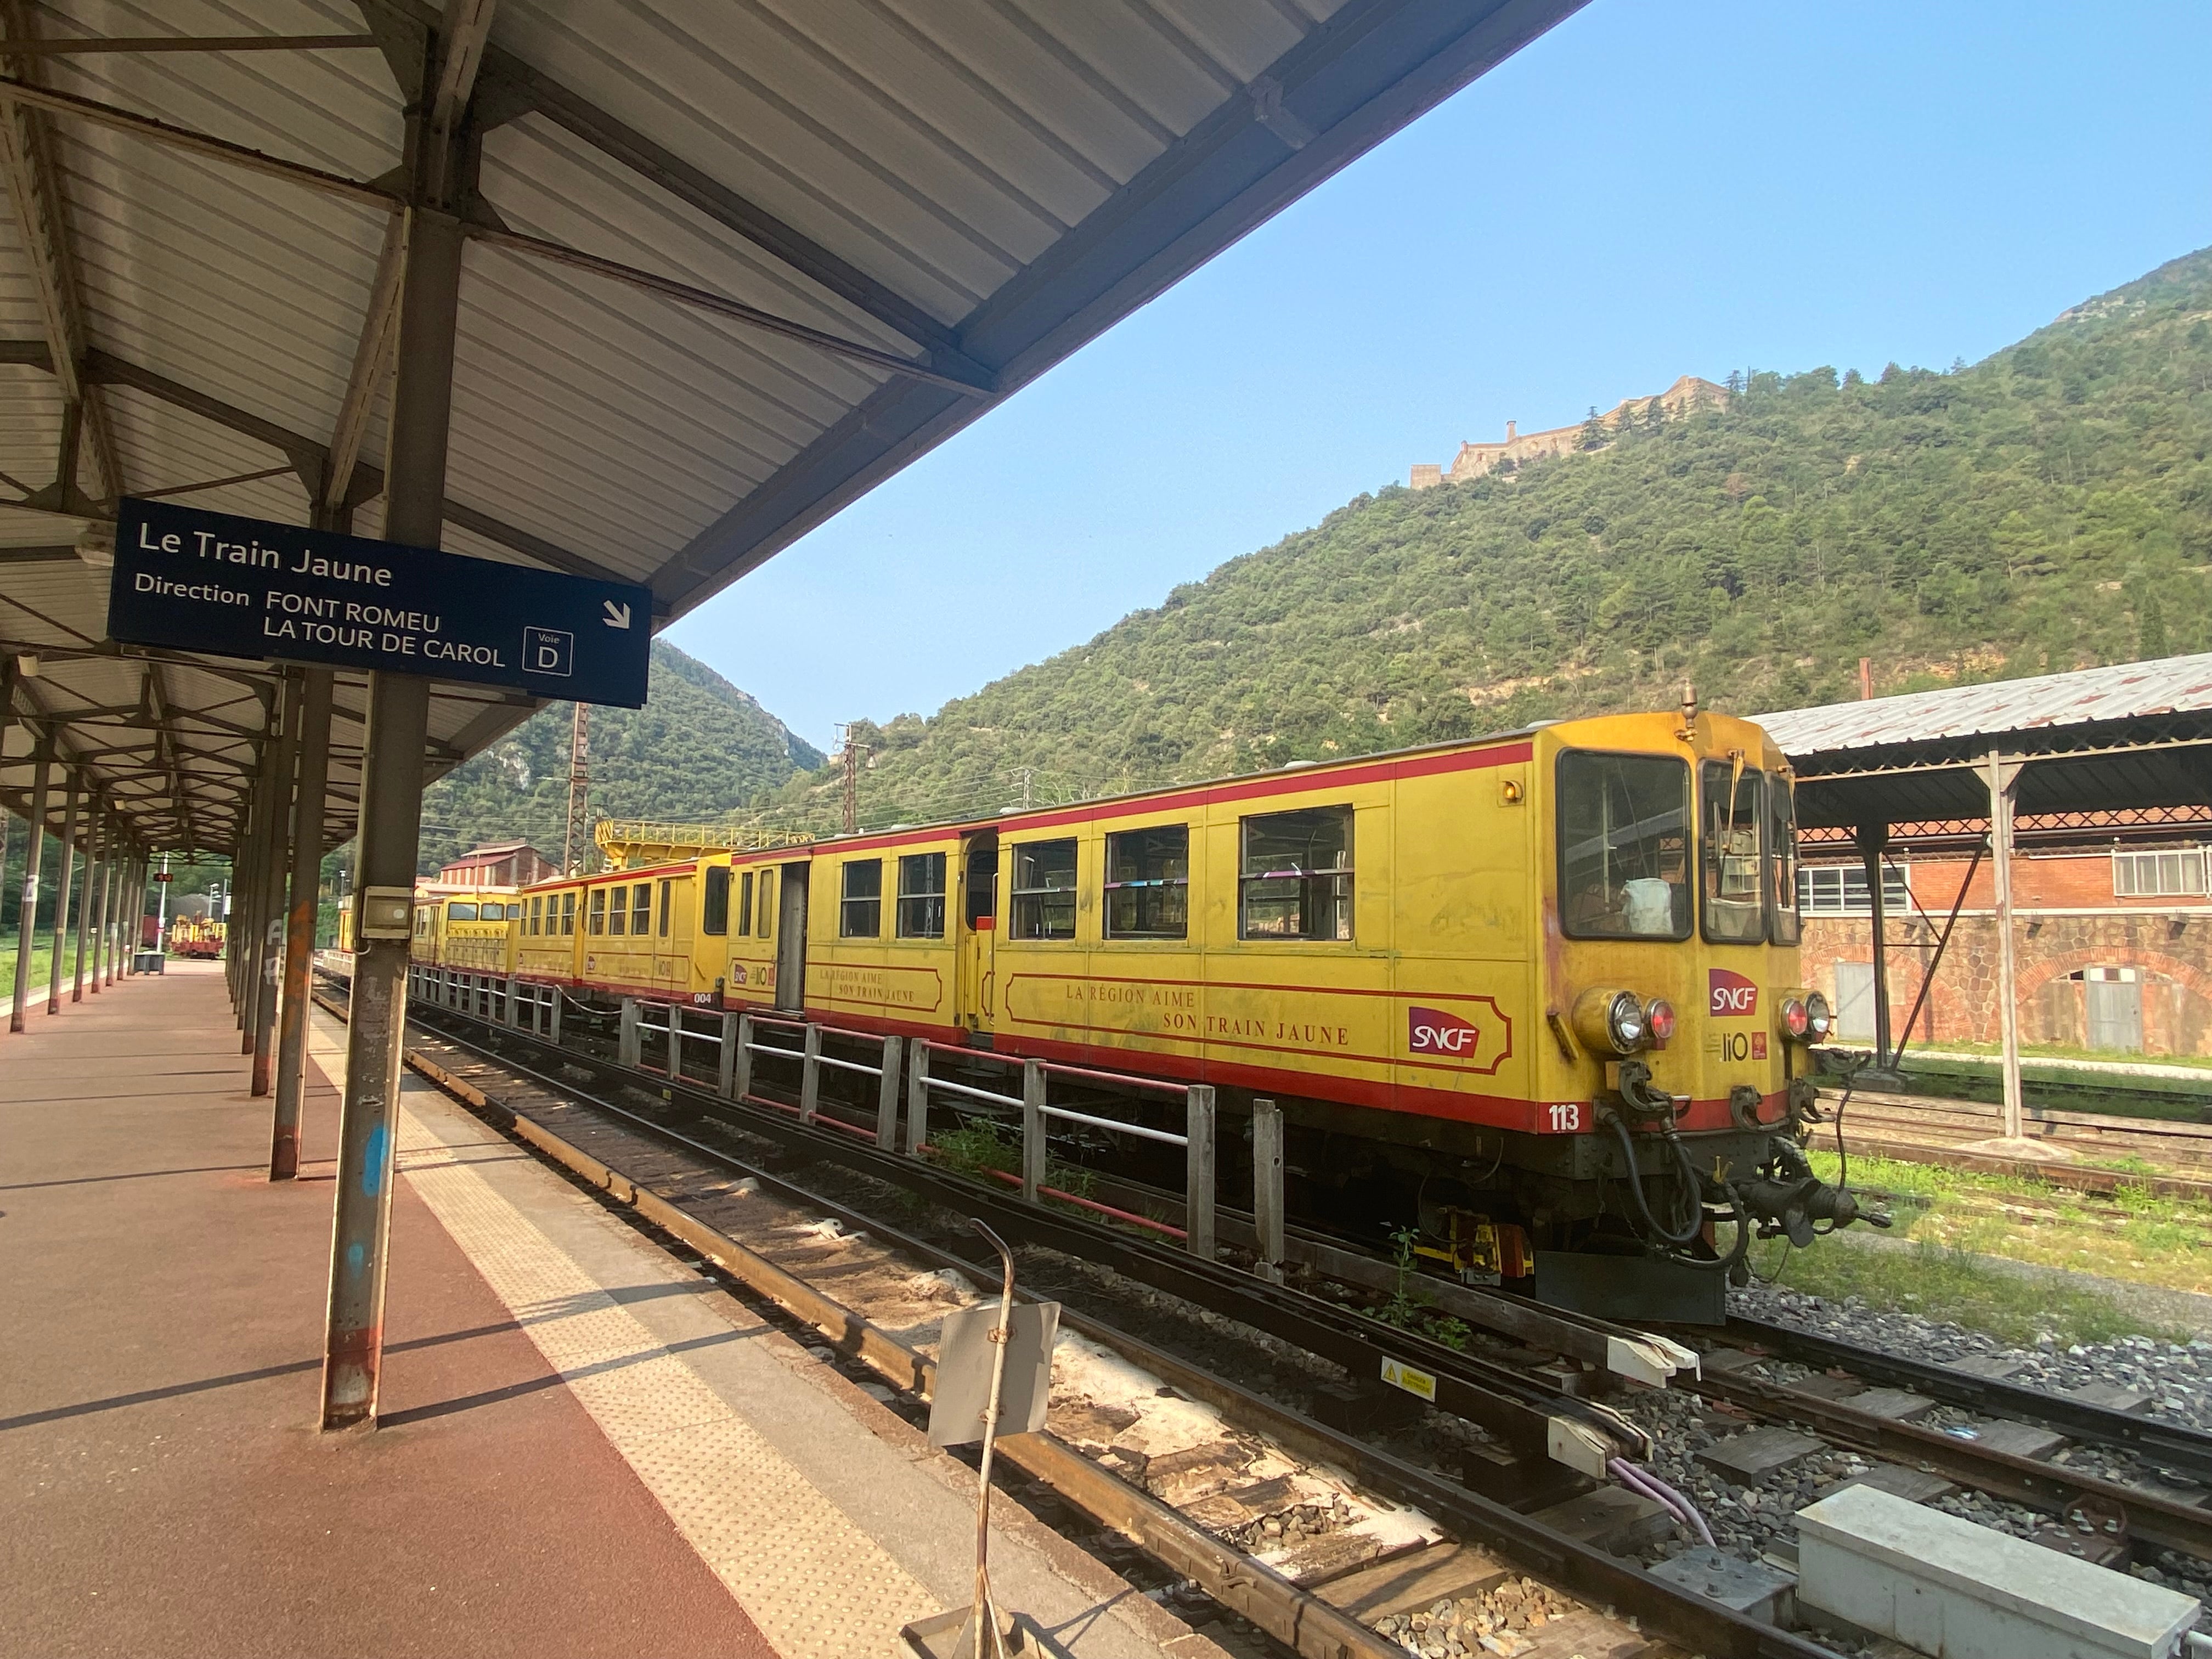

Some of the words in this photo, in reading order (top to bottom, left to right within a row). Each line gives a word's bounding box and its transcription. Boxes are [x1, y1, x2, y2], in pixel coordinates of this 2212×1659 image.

[139, 522, 181, 553] Le
[193, 531, 280, 569] Train
[291, 549, 391, 586] Jaune
[135, 573, 250, 606] Direction
[266, 591, 340, 618] FONT
[346, 603, 439, 633] ROMEU
[263, 617, 296, 640] LA
[301, 622, 373, 650] TOUR
[382, 633, 415, 656] DE
[424, 639, 506, 668] CAROL
[538, 632, 560, 644] Voie
[538, 646, 558, 669] D
[694, 994, 712, 1003] 004
[839, 984, 854, 995] SON
[857, 986, 883, 1000] TRAIN
[887, 990, 915, 1002] JAUNE
[1066, 985, 1083, 1000] LA
[1090, 983, 1144, 1003] RÉGION
[1153, 990, 1195, 1008] AIME
[1712, 988, 1757, 1012] SNCF
[1163, 1013, 1197, 1030] SON
[1206, 1016, 1265, 1036] TRAIN
[1276, 1023, 1348, 1046] JAUNE
[1412, 1024, 1477, 1051] SNCF
[1549, 1104, 1579, 1131] 113
